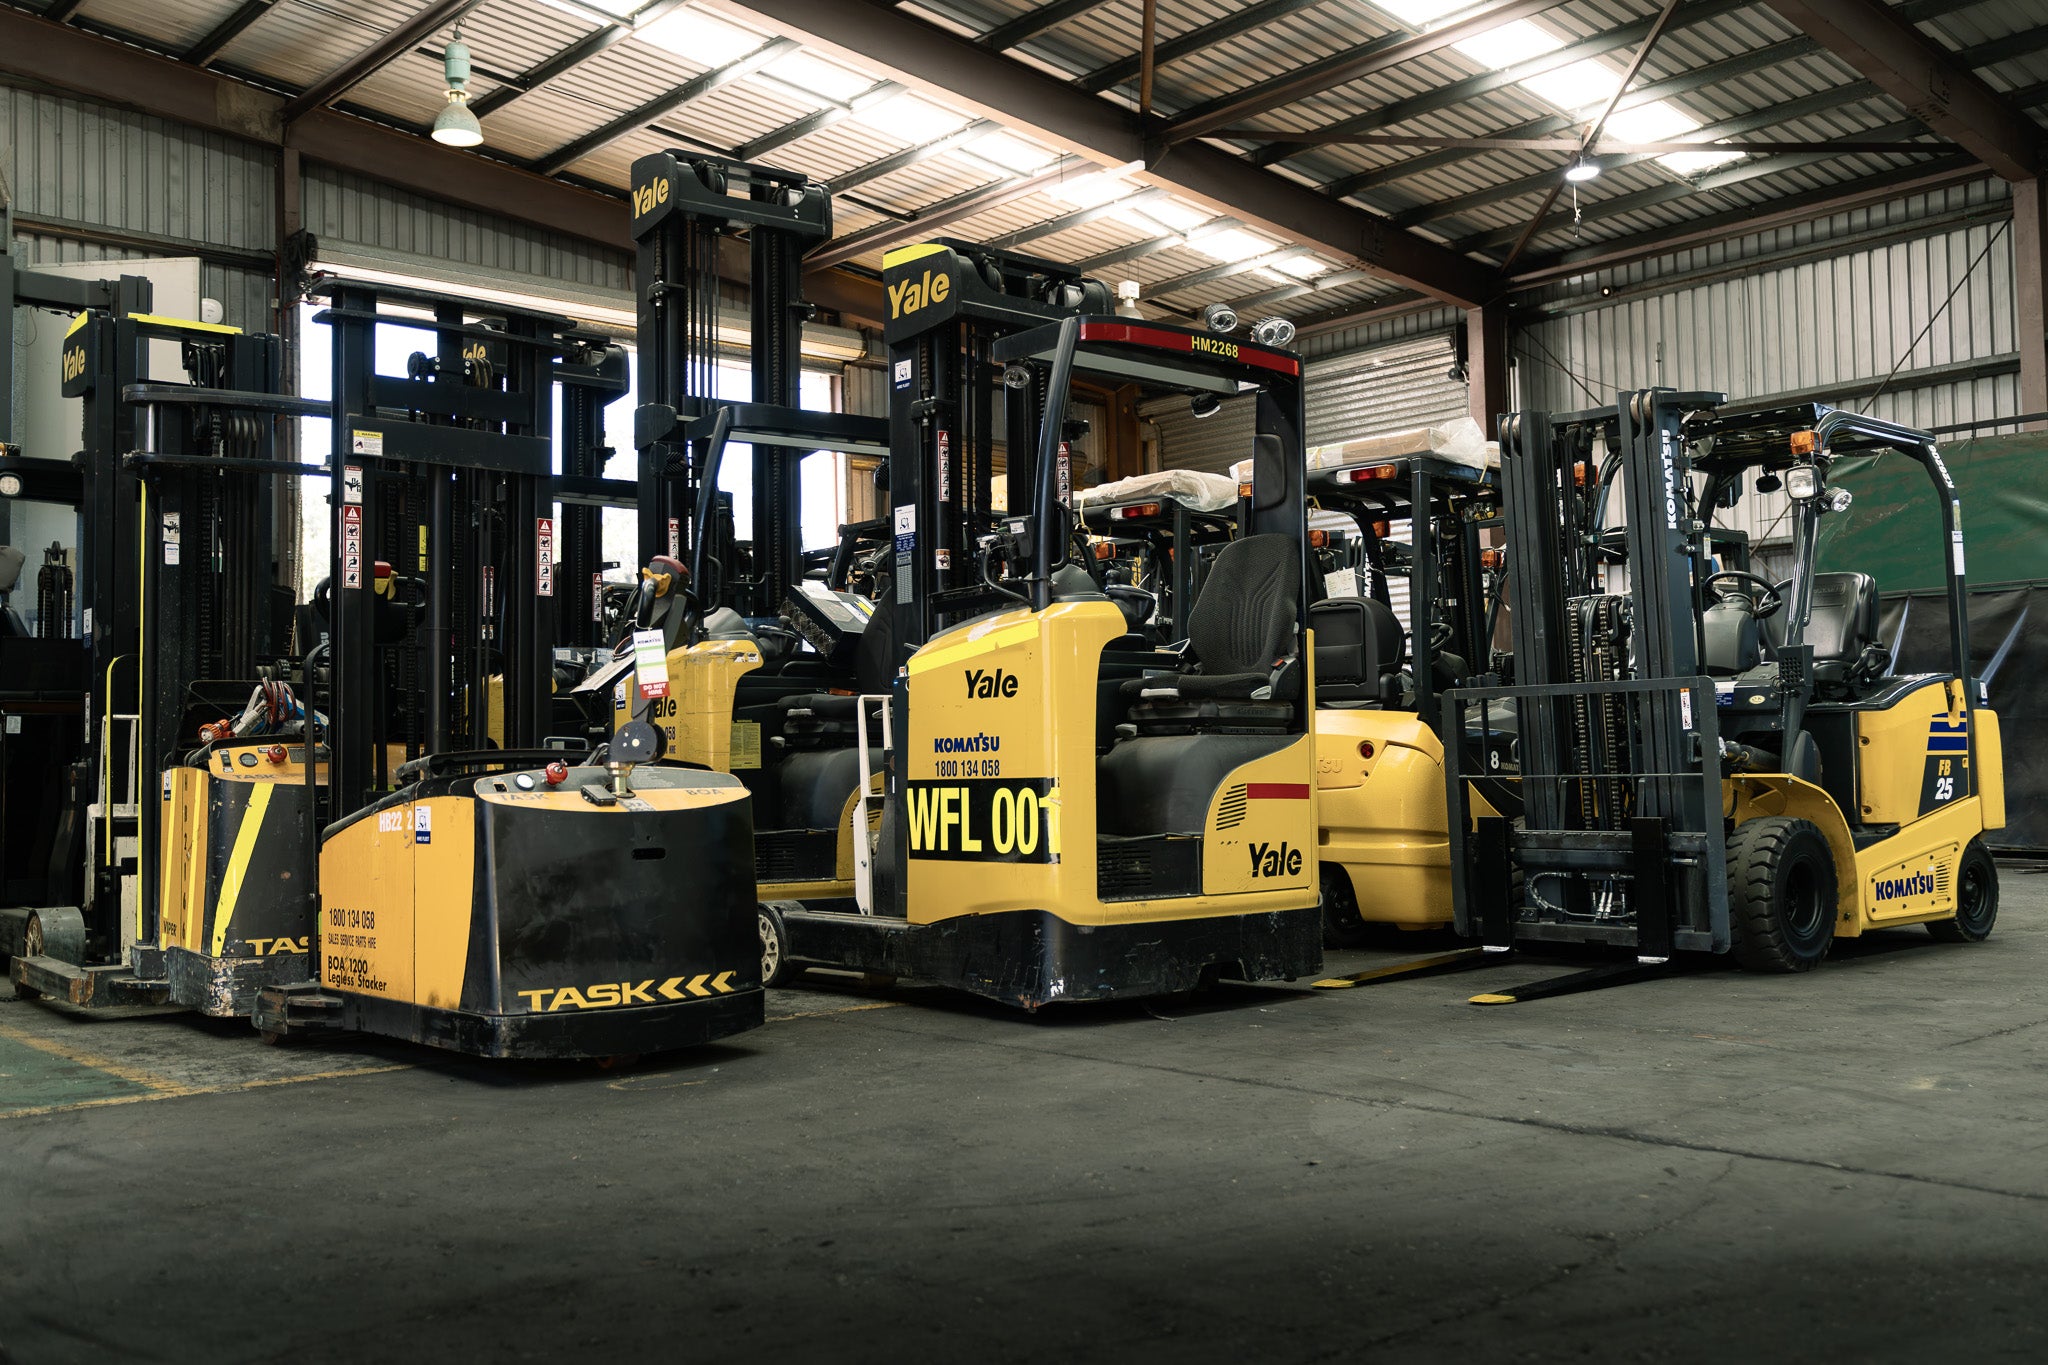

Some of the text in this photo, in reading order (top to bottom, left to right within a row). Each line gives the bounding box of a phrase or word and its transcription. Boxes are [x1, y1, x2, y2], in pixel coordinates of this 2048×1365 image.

[633, 176, 669, 220] Yale
[888, 269, 950, 320] Yale
[1191, 335, 1239, 358] HM2268
[63, 345, 85, 383] Yale
[1661, 429, 1677, 529] KOMATSU
[653, 682, 667, 690] NOT
[965, 668, 1018, 699] Yale
[655, 696, 677, 718] ale
[934, 732, 1000, 753] KOMATSU
[935, 759, 1000, 777] 1800 134 058
[1491, 751, 1500, 770] 8
[1938, 759, 1951, 776] FB
[1935, 777, 1953, 800] 25
[907, 787, 1061, 855] WFL 001
[1248, 841, 1303, 878] Yale
[1875, 870, 1934, 901] KOMATSU
[163, 920, 177, 937] VIPER
[329, 907, 375, 930] 1800 134 058
[328, 932, 339, 945] SALES
[340, 933, 355, 947] SERVICE
[355, 935, 367, 948] PARTS
[328, 955, 368, 974] BOA 1200
[328, 969, 387, 993] Legless Stacker
[517, 979, 657, 1012] TASK
